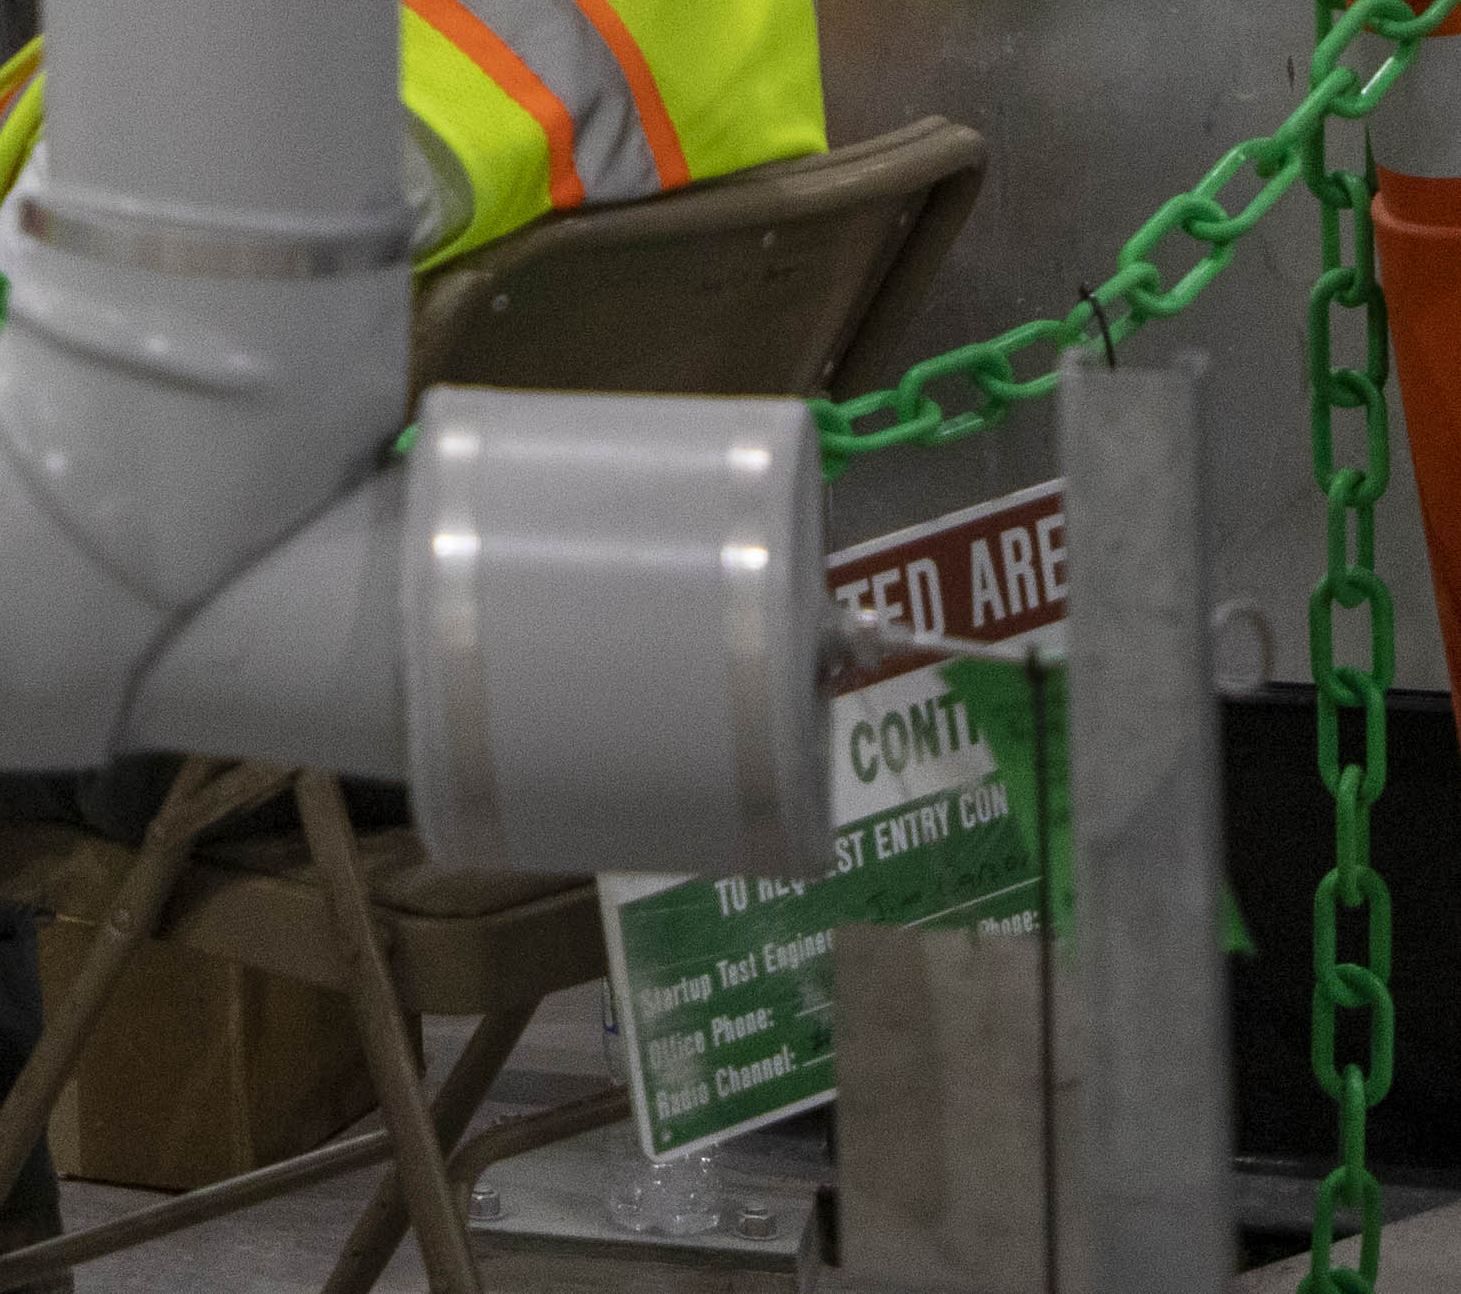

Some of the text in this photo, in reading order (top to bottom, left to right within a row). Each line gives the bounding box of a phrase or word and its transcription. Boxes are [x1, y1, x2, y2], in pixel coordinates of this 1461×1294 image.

[970, 513, 1068, 628] ARE
[874, 798, 950, 861] ENTRY
[637, 973, 712, 1020] Startup
[716, 951, 757, 989] Test
[712, 1005, 774, 1046] Phone:
[715, 1045, 797, 1097] Channel:
